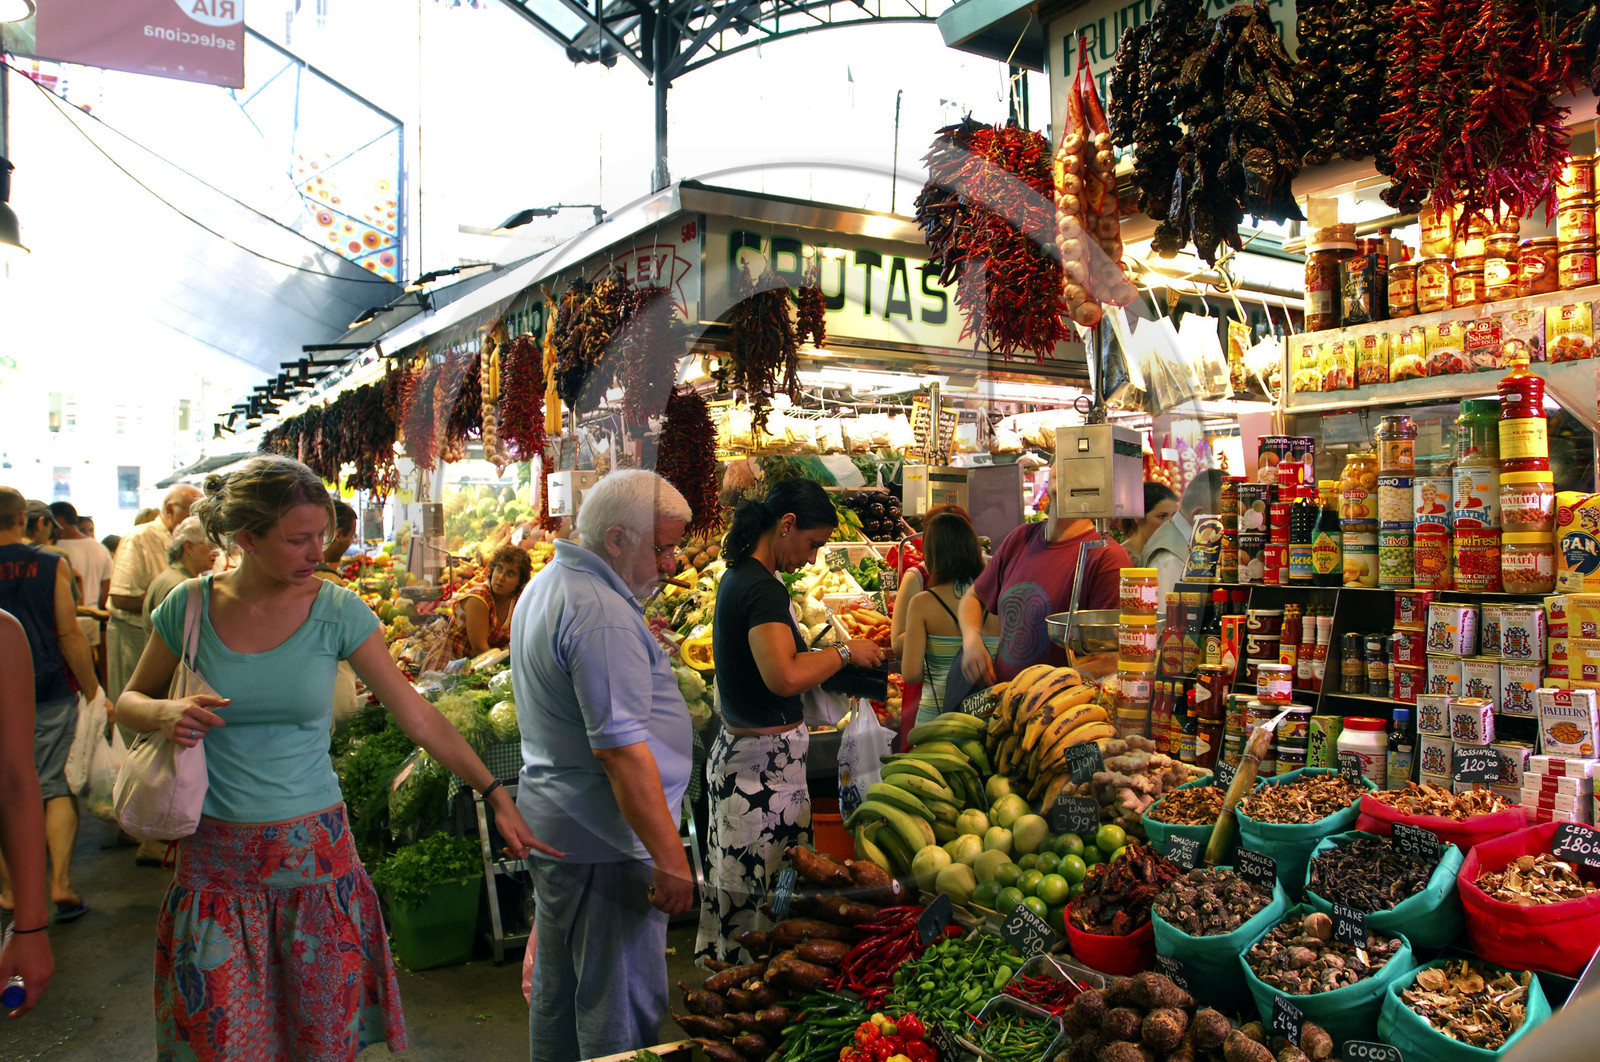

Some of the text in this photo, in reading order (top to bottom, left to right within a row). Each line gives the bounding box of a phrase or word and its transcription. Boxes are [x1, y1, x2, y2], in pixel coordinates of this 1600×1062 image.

[681, 221, 697, 243] 509
[622, 254, 668, 285] LEY
[1359, 350, 1384, 361] Pizza
[962, 693, 985, 713] PLATA
[1543, 706, 1587, 718] PAELLERO
[1457, 749, 1497, 758] ROSSINYOL
[1218, 760, 1238, 775] MOIXE
[1460, 758, 1498, 773] 120'00
[1220, 771, 1234, 785] 90
[1069, 806, 1095, 814] LIMON
[1057, 814, 1090, 832] 2'99
[1566, 825, 1593, 839] CEPS
[1170, 835, 1200, 848] TOMAQUET
[1401, 839, 1434, 854] 95'00
[1167, 848, 1193, 861] 22'00
[1238, 849, 1273, 867] MURGULES
[1240, 860, 1273, 877] 360'00
[1015, 905, 1051, 936] PADRON
[1334, 905, 1363, 922] SITAKE
[1338, 920, 1363, 939] 84'00
[1349, 1044, 1396, 1062] COCOS
